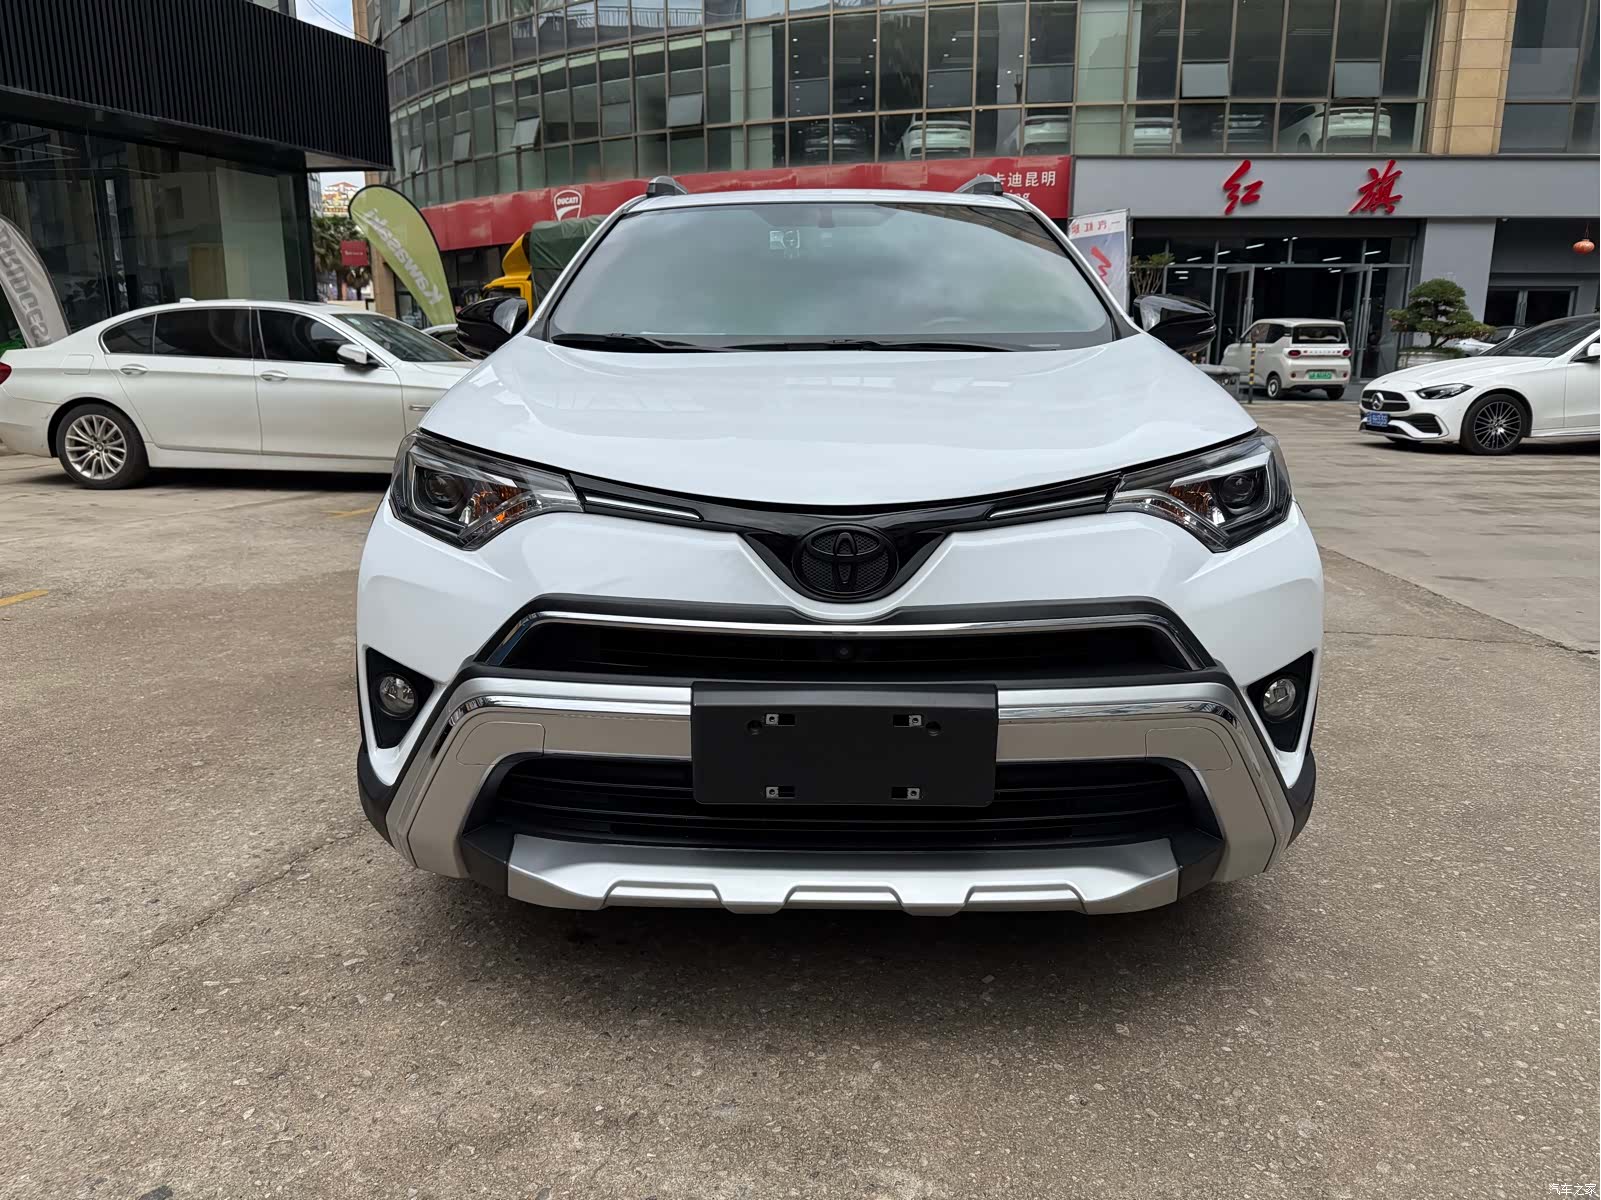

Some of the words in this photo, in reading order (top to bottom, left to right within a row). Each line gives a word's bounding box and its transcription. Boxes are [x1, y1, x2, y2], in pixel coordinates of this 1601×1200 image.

[977, 171, 1056, 187] 卡迪昆明
[1223, 159, 1403, 215] 红旗
[557, 196, 579, 206] DUCATI
